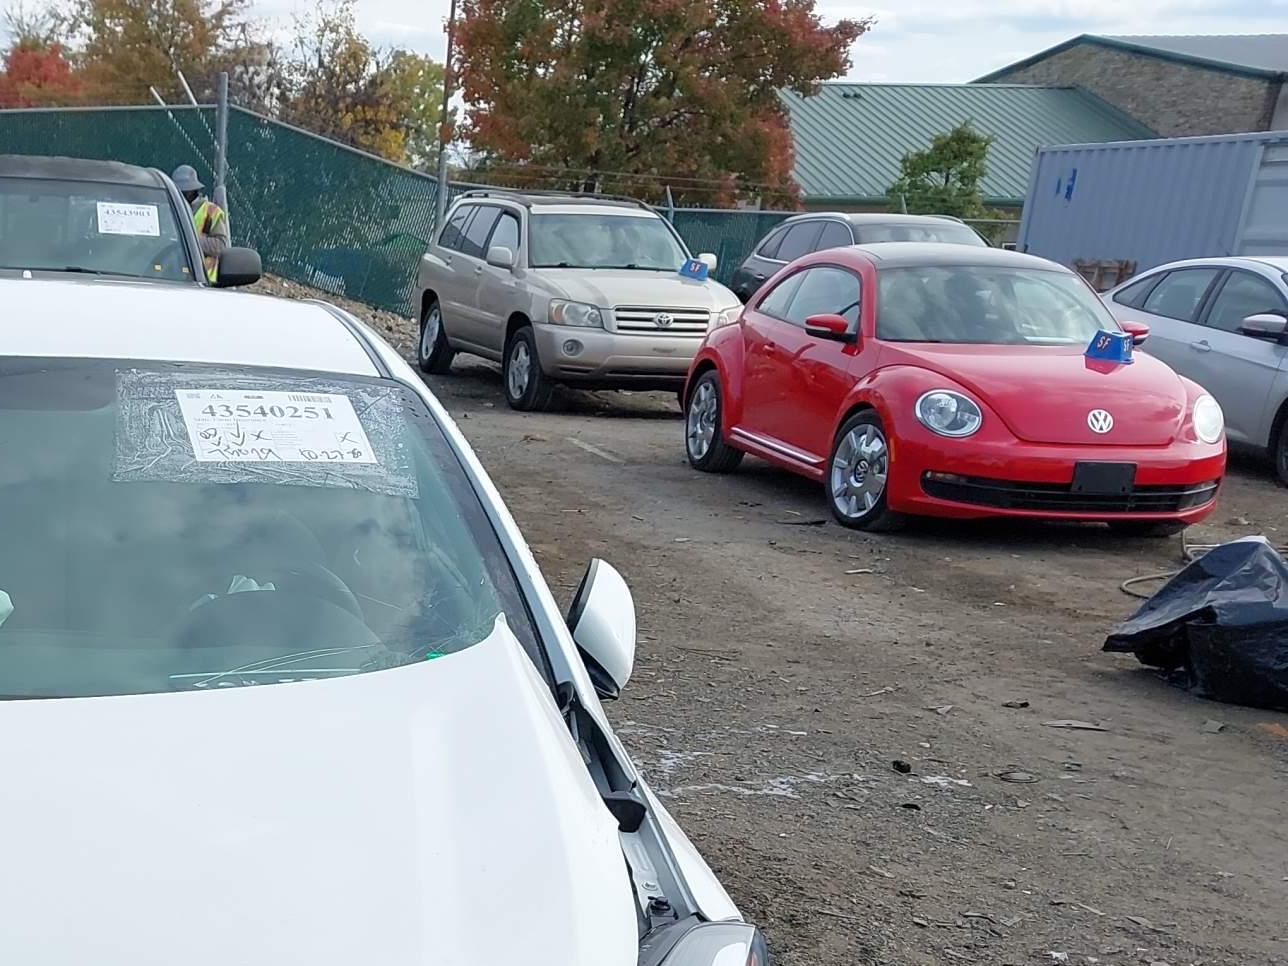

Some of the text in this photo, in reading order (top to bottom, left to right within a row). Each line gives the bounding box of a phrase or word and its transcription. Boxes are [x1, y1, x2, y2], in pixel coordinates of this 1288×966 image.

[1097, 335, 1112, 349] SF
[201, 404, 334, 419] 43540251
[1087, 408, 1114, 434] VW
